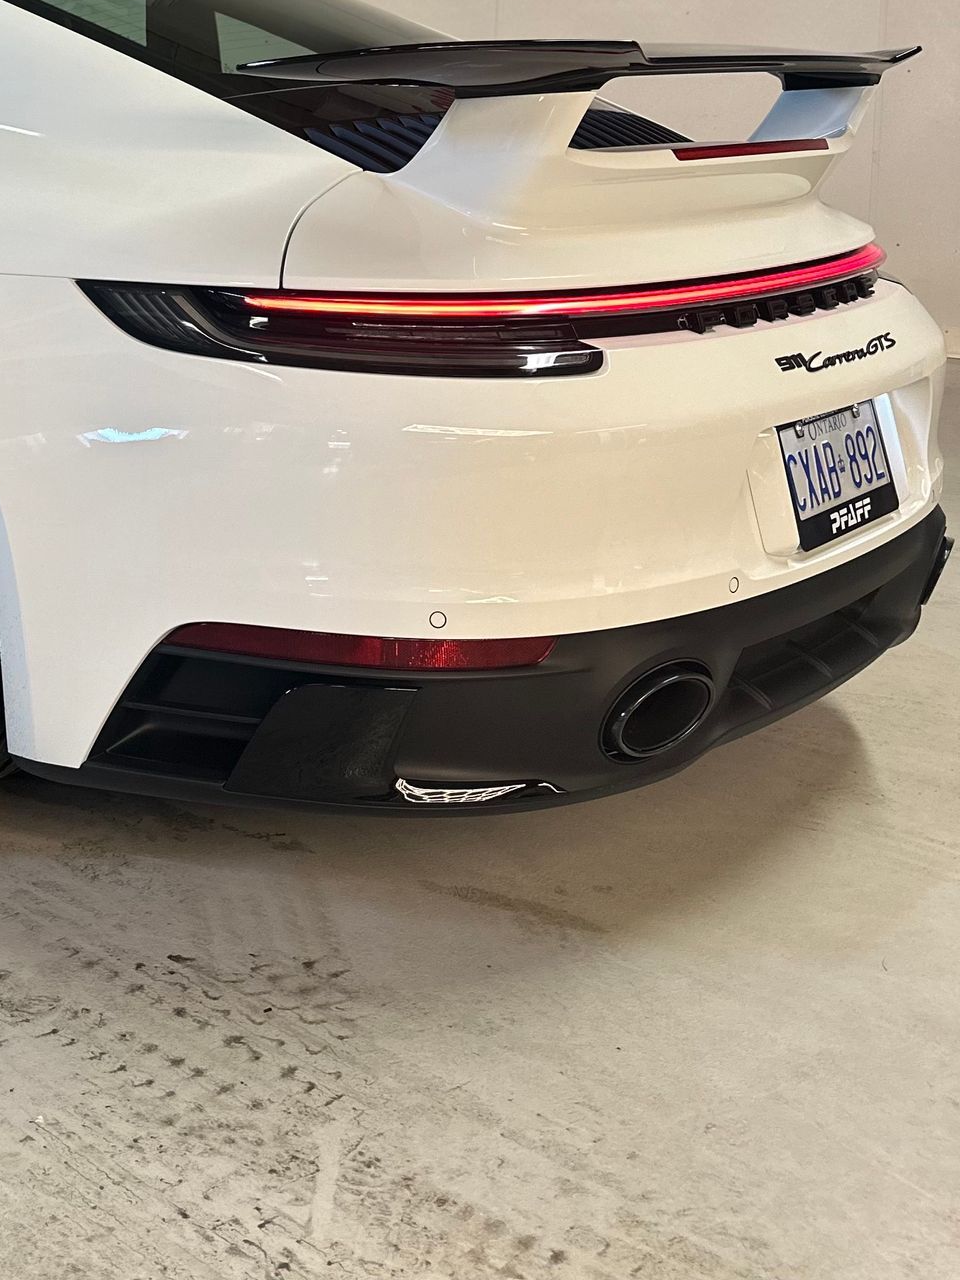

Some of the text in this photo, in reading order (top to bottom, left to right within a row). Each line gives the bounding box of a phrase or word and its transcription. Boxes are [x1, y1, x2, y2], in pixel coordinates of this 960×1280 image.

[806, 348, 869, 373] Carrera
[866, 332, 896, 356] GTS
[786, 425, 886, 513] CXAB 892
[830, 497, 872, 534] PFAFF
